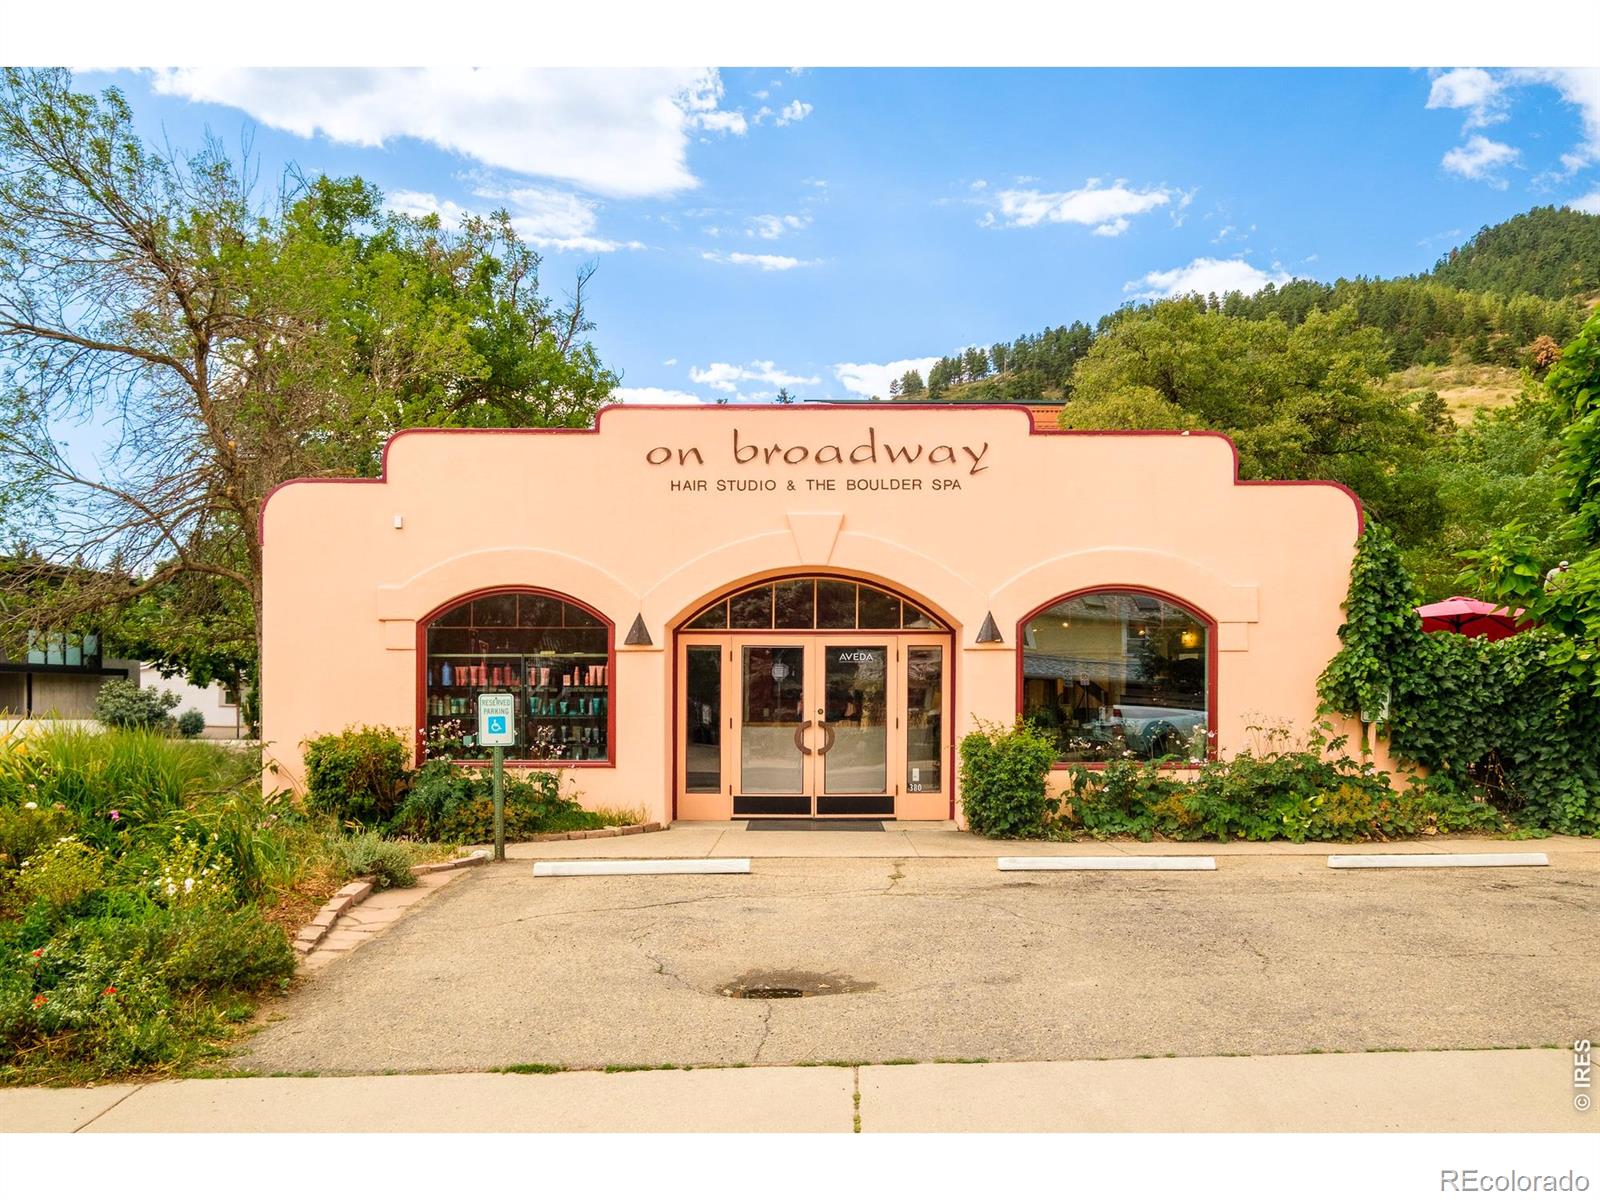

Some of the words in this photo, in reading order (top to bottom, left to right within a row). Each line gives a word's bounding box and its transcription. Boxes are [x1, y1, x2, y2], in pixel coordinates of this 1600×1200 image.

[646, 447, 704, 466] on
[733, 427, 990, 475] broadway
[670, 479, 708, 492] HAIR
[716, 479, 777, 492] STUDIO
[786, 480, 796, 492] &
[806, 479, 836, 492] THE
[846, 479, 923, 492] BOULDER
[932, 479, 962, 492] SPA
[839, 652, 874, 661] AVEDA
[909, 783, 923, 792] 380
